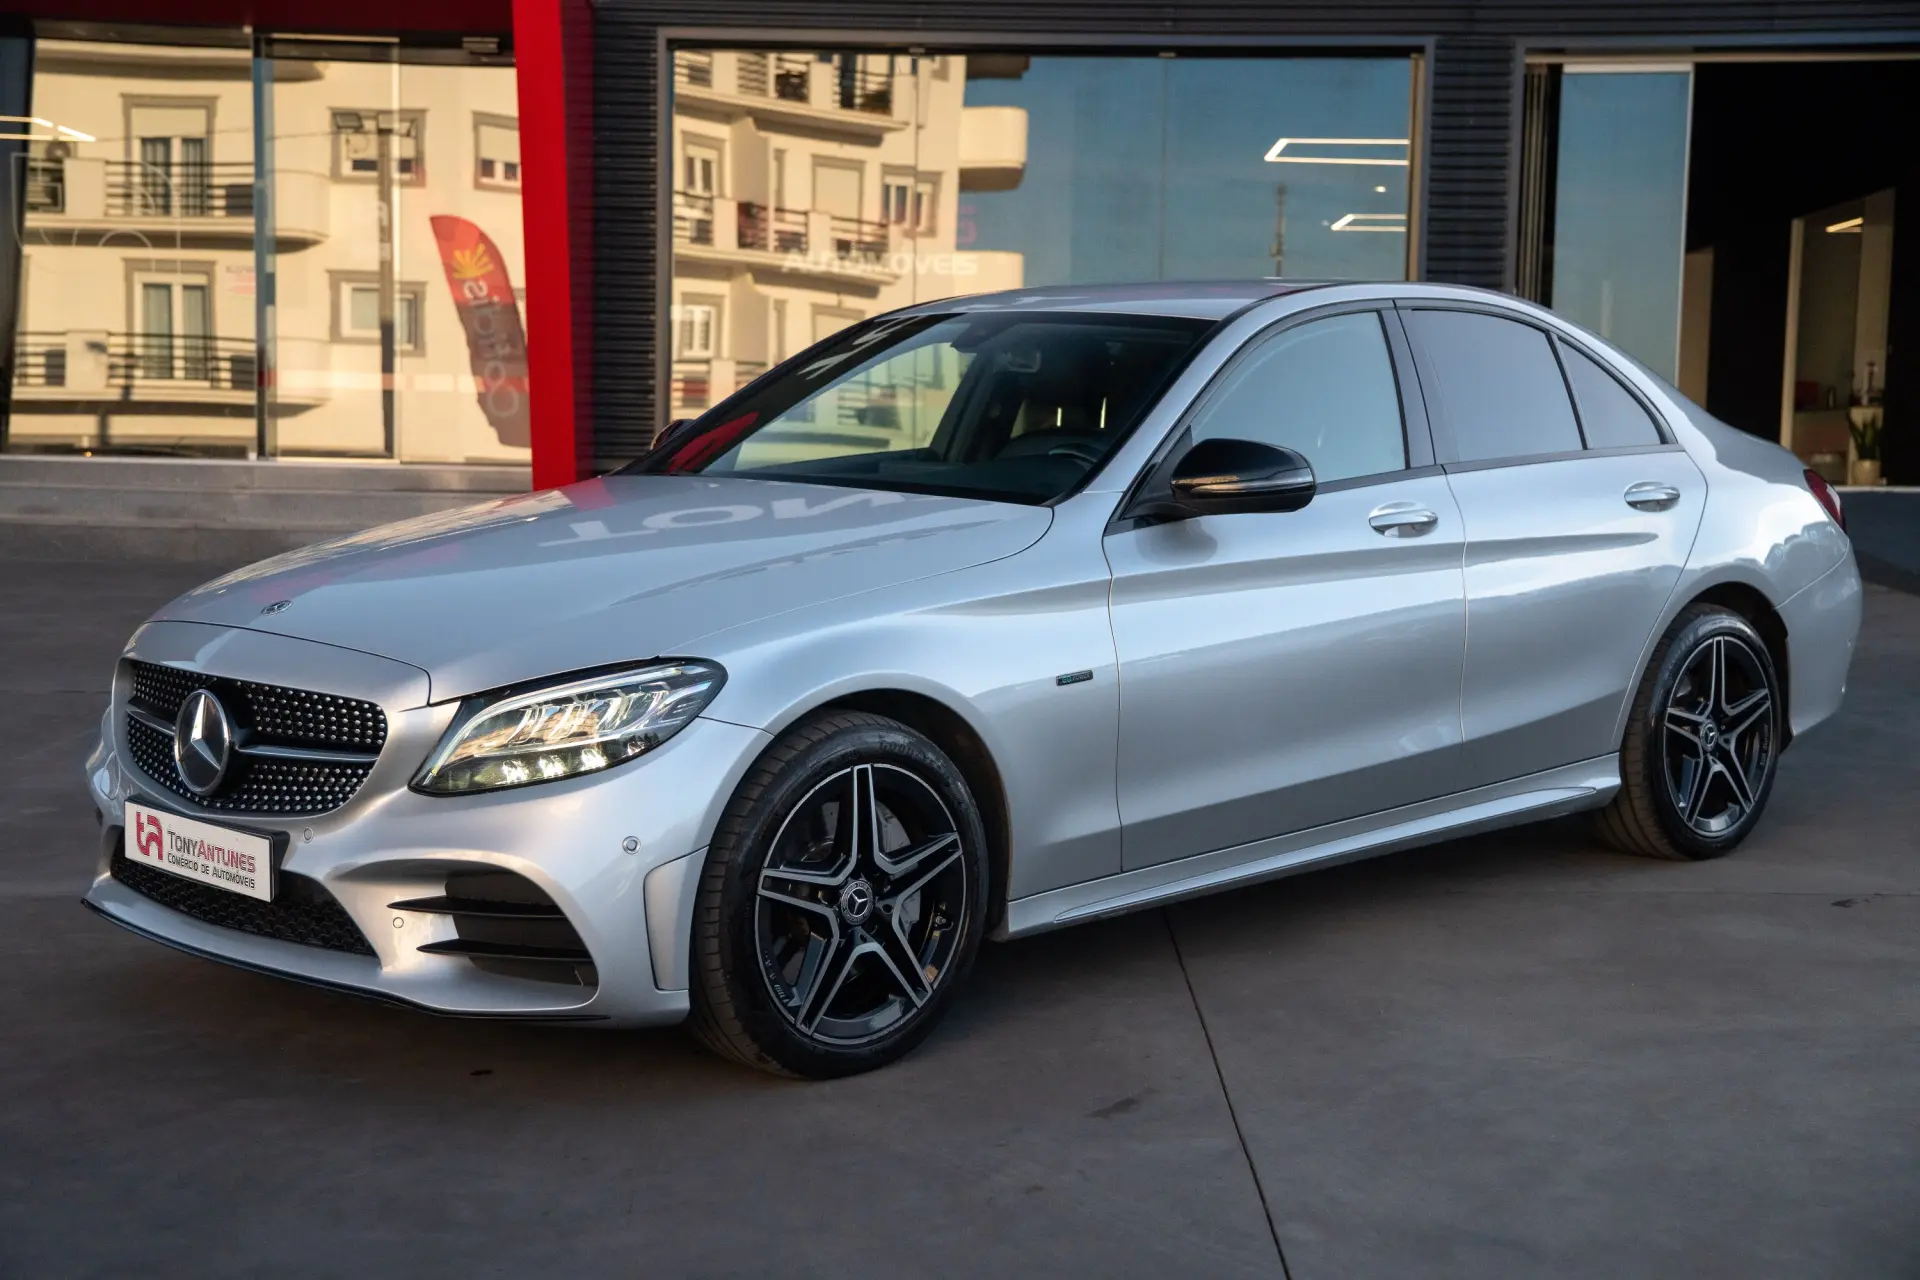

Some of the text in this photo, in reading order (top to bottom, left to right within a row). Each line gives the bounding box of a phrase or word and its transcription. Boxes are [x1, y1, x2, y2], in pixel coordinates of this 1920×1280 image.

[167, 852, 256, 889] COMÉRCIO DE AUTOMÓVEIS
